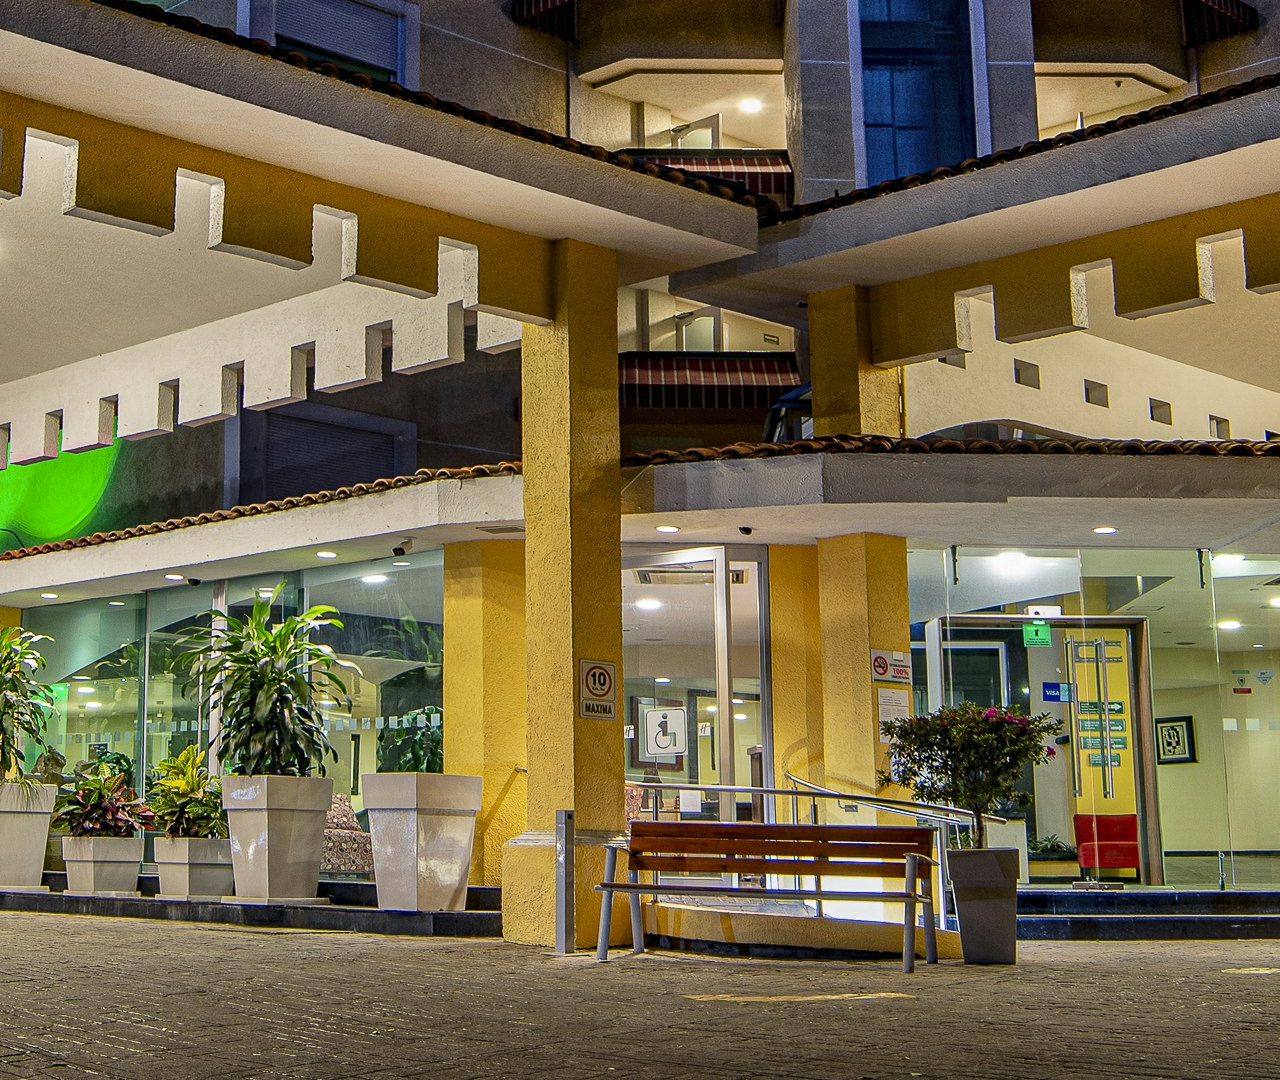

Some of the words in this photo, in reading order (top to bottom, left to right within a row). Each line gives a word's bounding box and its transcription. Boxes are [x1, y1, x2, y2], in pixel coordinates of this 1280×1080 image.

[892, 667, 909, 676] 100%
[591, 671, 606, 687] 10
[585, 702, 613, 715] MAXIMA
